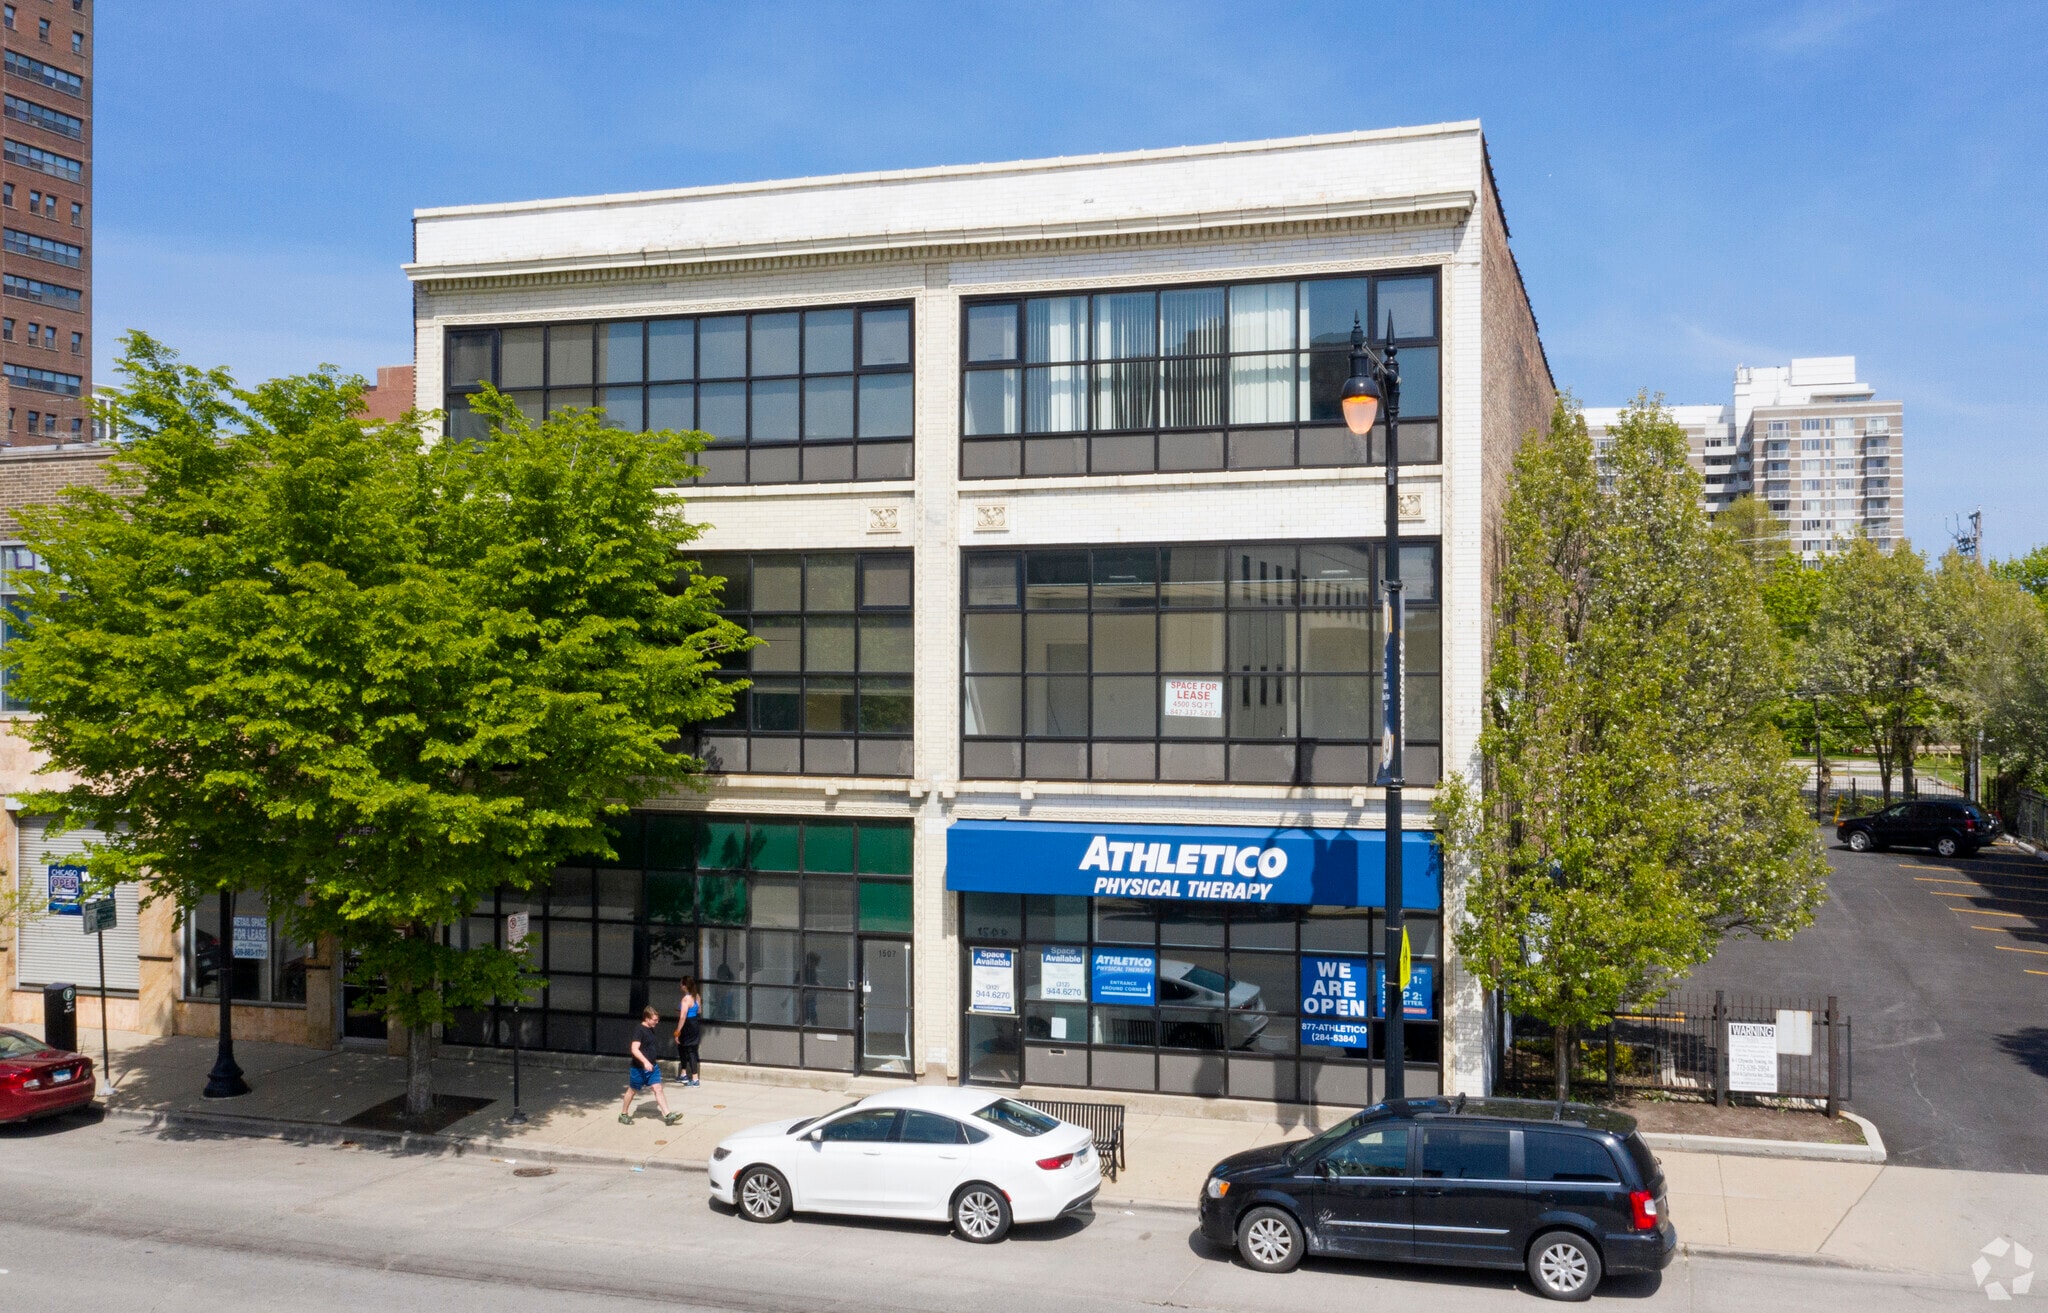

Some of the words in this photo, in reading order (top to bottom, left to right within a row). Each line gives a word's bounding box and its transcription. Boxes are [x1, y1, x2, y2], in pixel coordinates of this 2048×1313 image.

[1171, 681, 1197, 689] SPACE
[1177, 690, 1211, 700] LEASE
[1078, 835, 1288, 879] ATHLETICO
[51, 869, 78, 877] CHICAGO
[52, 878, 77, 888] OPEN
[1093, 877, 1181, 897] PHYSICAL
[1187, 880, 1273, 900] THERAPY
[233, 928, 247, 940] FOR
[248, 928, 267, 941] LEASE
[878, 949, 897, 958] 1507
[981, 950, 1005, 959] Space
[1051, 946, 1076, 955] Space
[975, 958, 1010, 967] Available
[1045, 954, 1081, 963] Available
[1095, 954, 1152, 967] ATHLETICO
[1317, 961, 1352, 979] WE
[1412, 975, 1422, 985] 1:
[1046, 987, 1081, 997] 944.6270
[1312, 979, 1357, 998] ARE
[975, 989, 1010, 999] 944.6270
[1412, 991, 1422, 1001] 2:
[1303, 997, 1365, 1017] OPEN
[1301, 1022, 1368, 1034] 877-ATHLETICO
[1731, 1025, 1774, 1037] WARNING
[1311, 1032, 1357, 1045] (284-5384)
